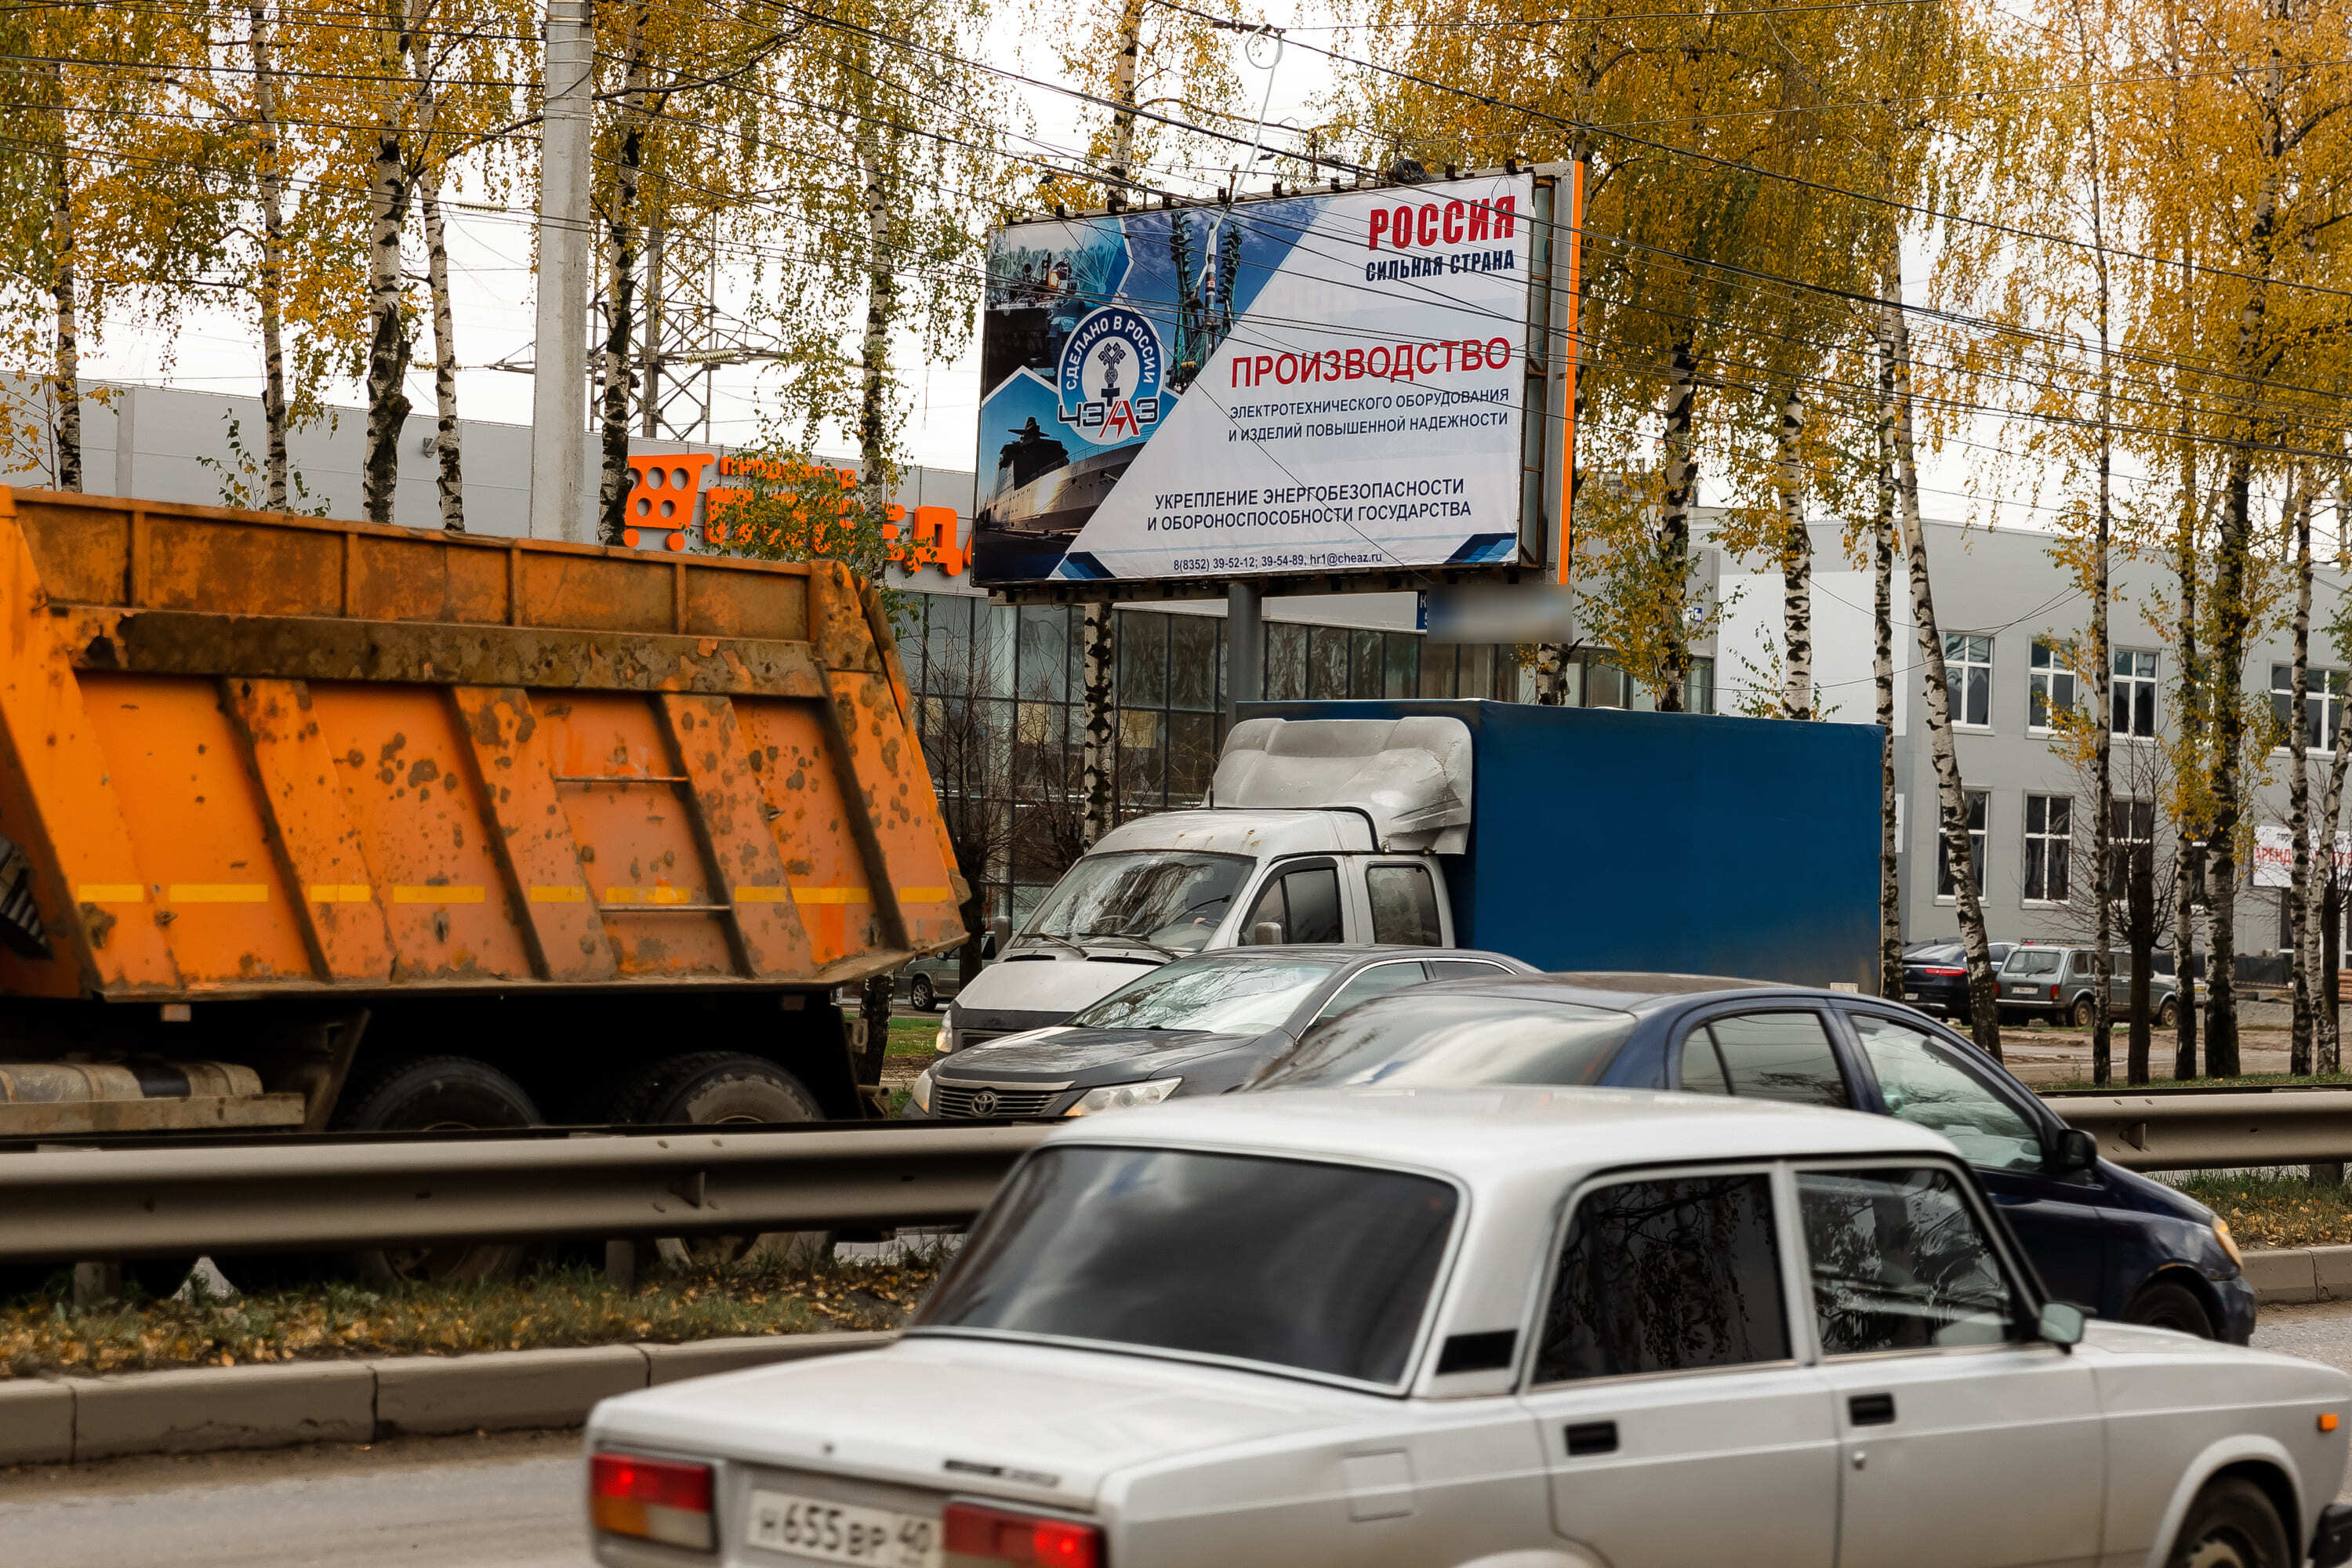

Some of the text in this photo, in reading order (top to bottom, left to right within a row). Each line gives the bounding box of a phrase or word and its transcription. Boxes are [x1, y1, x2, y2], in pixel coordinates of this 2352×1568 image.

[1369, 195, 1515, 251] РОССИЯ
[1366, 250, 1515, 281] СИЛЬНАЯ СТРАНА
[1066, 316, 1156, 390] СДЕЛАНО В РОССИИ
[1231, 337, 1511, 388] ПРОИЗВОДСТВО
[1230, 389, 1509, 419] ЭЛЕКТРОТЕХНИЧЕСКОГО ОБОРУДОВАНИЯ
[1229, 412, 1508, 443] И ИЗДЕЛИЙ ПОВЫШЕННОЙ НАДЕЖНОСТИ
[1155, 478, 1465, 510] УКРЕПЛЕНИЕ ЭНЕРГОБЕЗОПАСНОСТИ
[1147, 500, 1472, 531] И ОБОРОНОСПОСОБНОСТИ ГОСУДАРСТВА
[1174, 553, 1382, 572] 8(8352) 39-52-12; 39-54-89, hr1@cheaz.ru
[2255, 847, 2309, 866] АРЕНД
